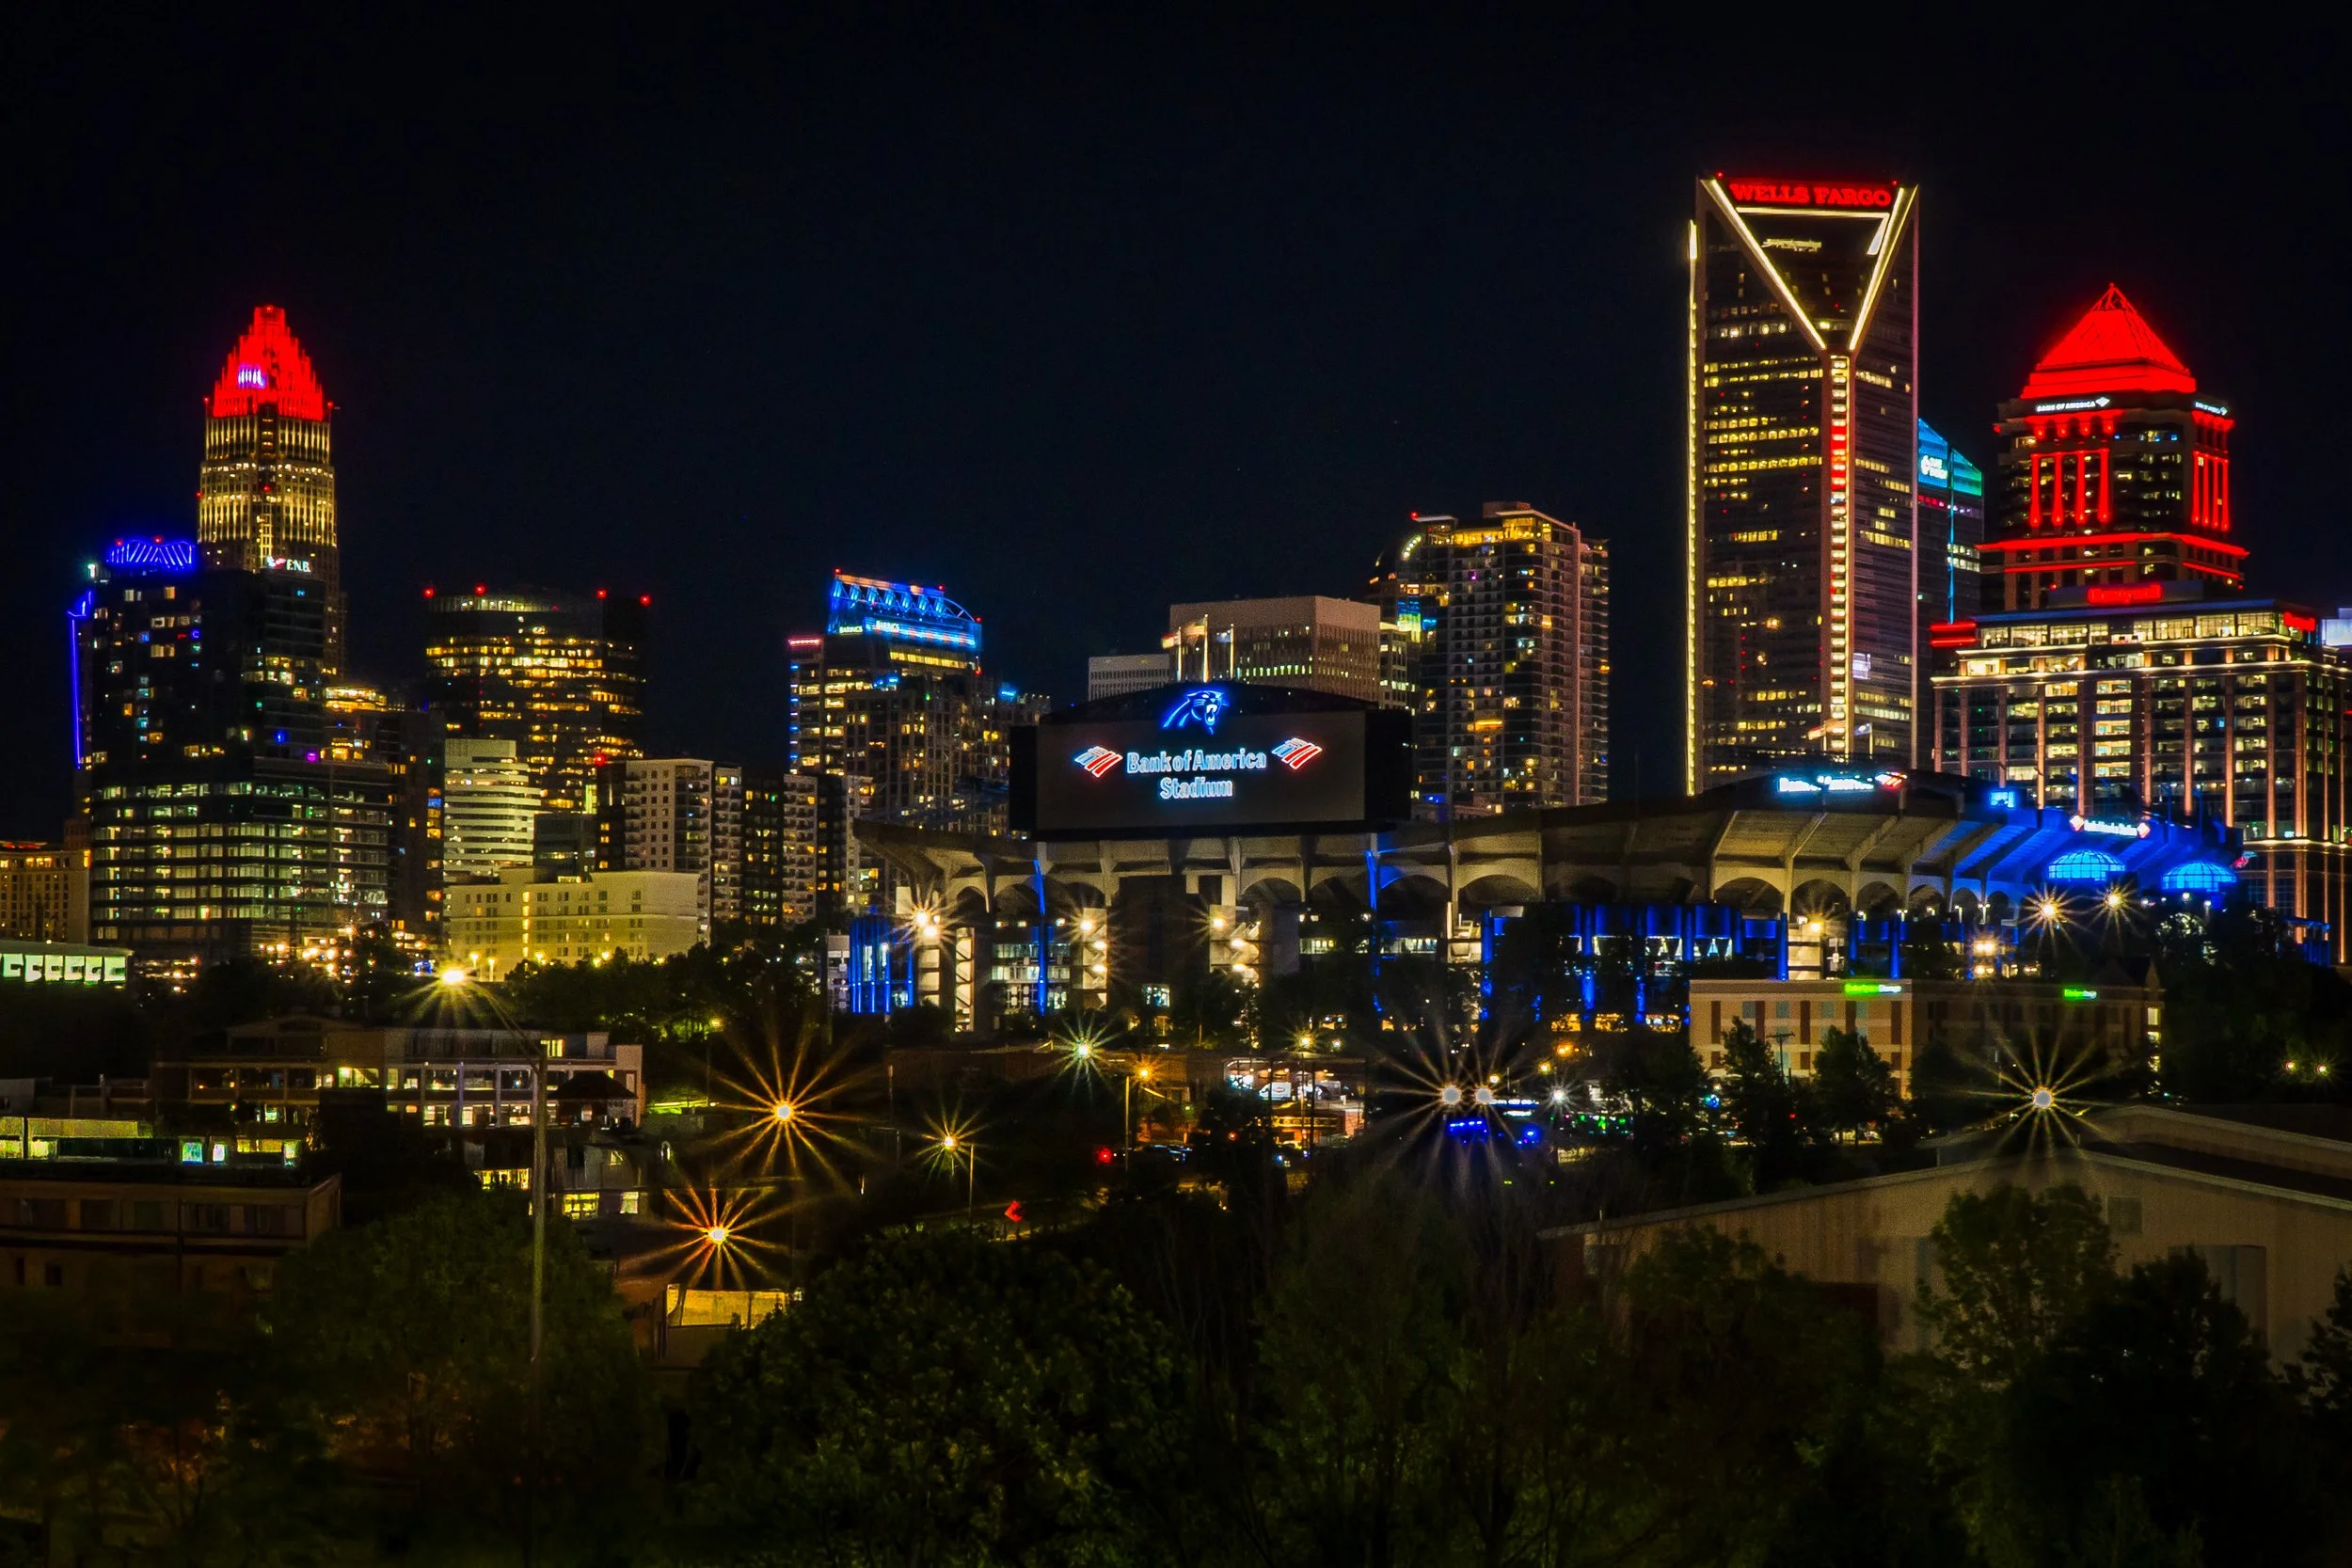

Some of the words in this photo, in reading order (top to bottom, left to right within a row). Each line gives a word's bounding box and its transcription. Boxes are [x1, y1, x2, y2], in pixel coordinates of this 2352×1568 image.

[1729, 183, 1810, 203] WELLS
[1814, 187, 1892, 207] FARGO
[1126, 752, 1172, 773] Bank
[1172, 750, 1192, 771] of
[1192, 748, 1267, 770] America
[1159, 777, 1233, 799] Stadium
